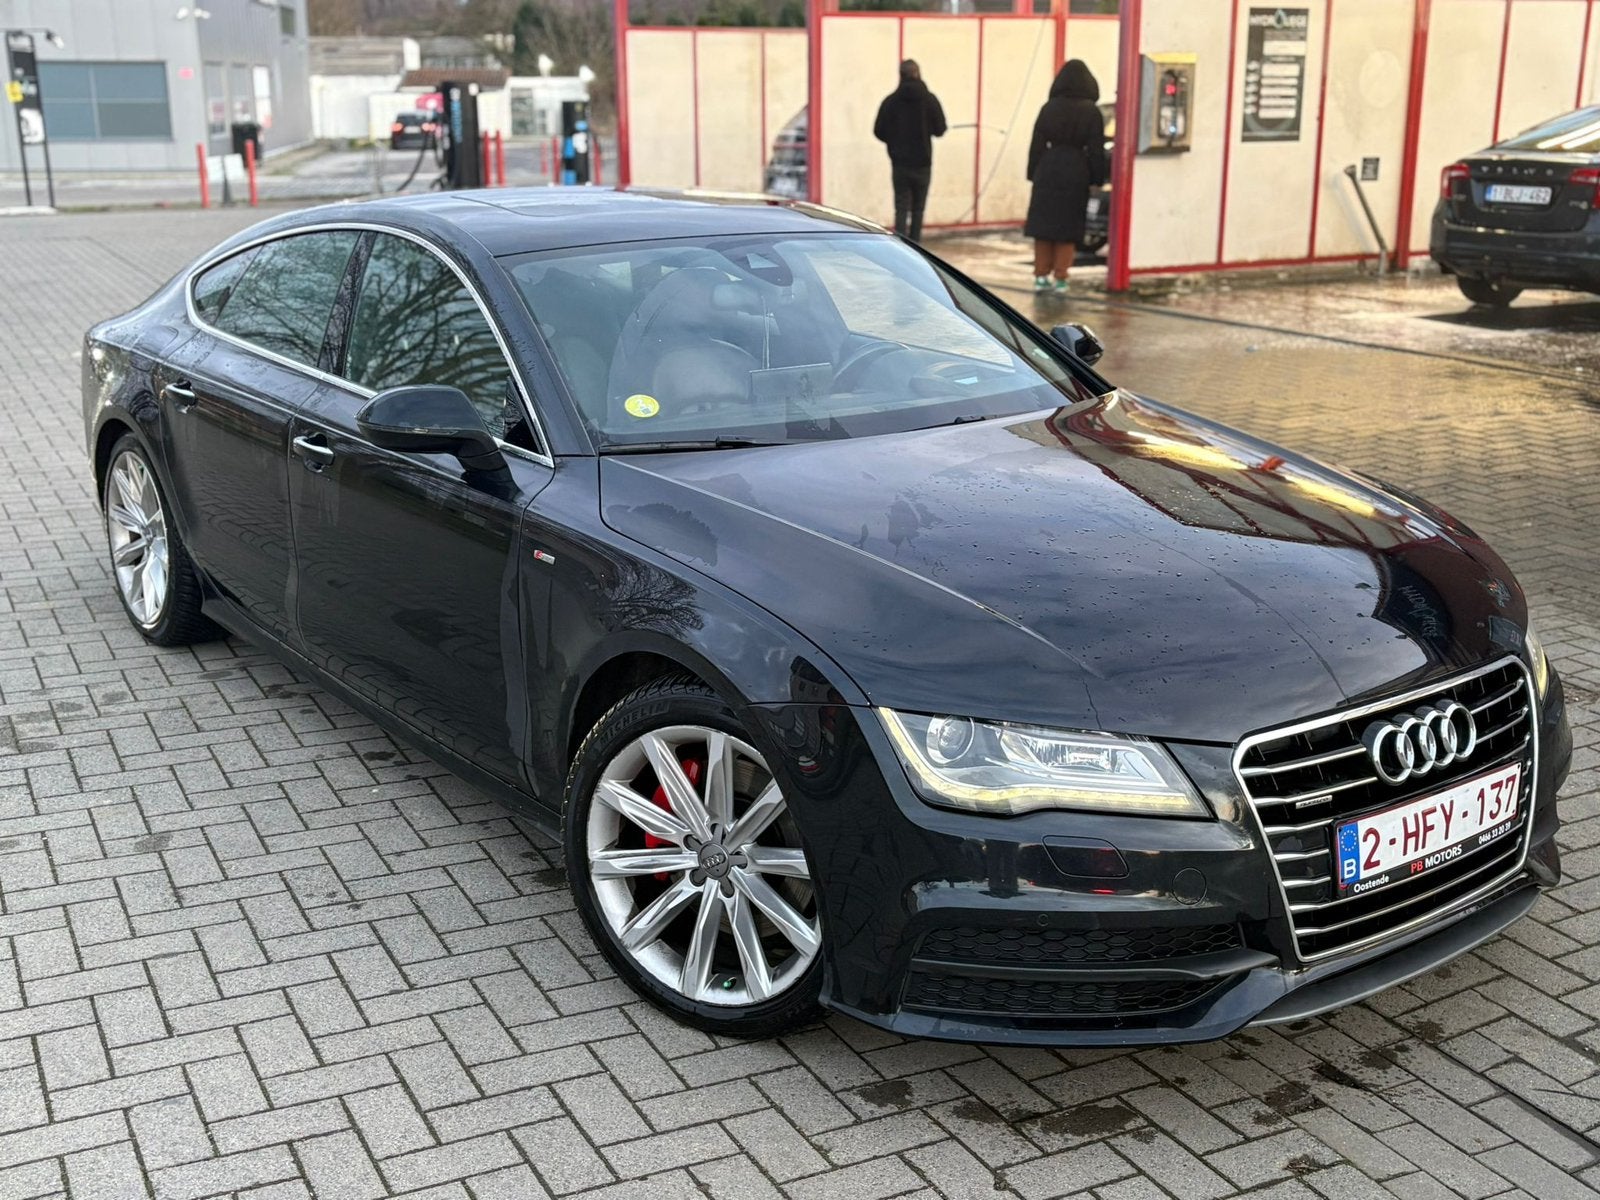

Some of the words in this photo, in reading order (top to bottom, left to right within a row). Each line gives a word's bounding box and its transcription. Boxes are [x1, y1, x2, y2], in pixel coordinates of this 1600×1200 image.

[600, 702, 670, 746] MICHELIN
[1343, 858, 1357, 879] B
[1410, 861, 1424, 874] PB
[1424, 844, 1463, 869] MOTORS
[1353, 874, 1390, 893] Oostende
